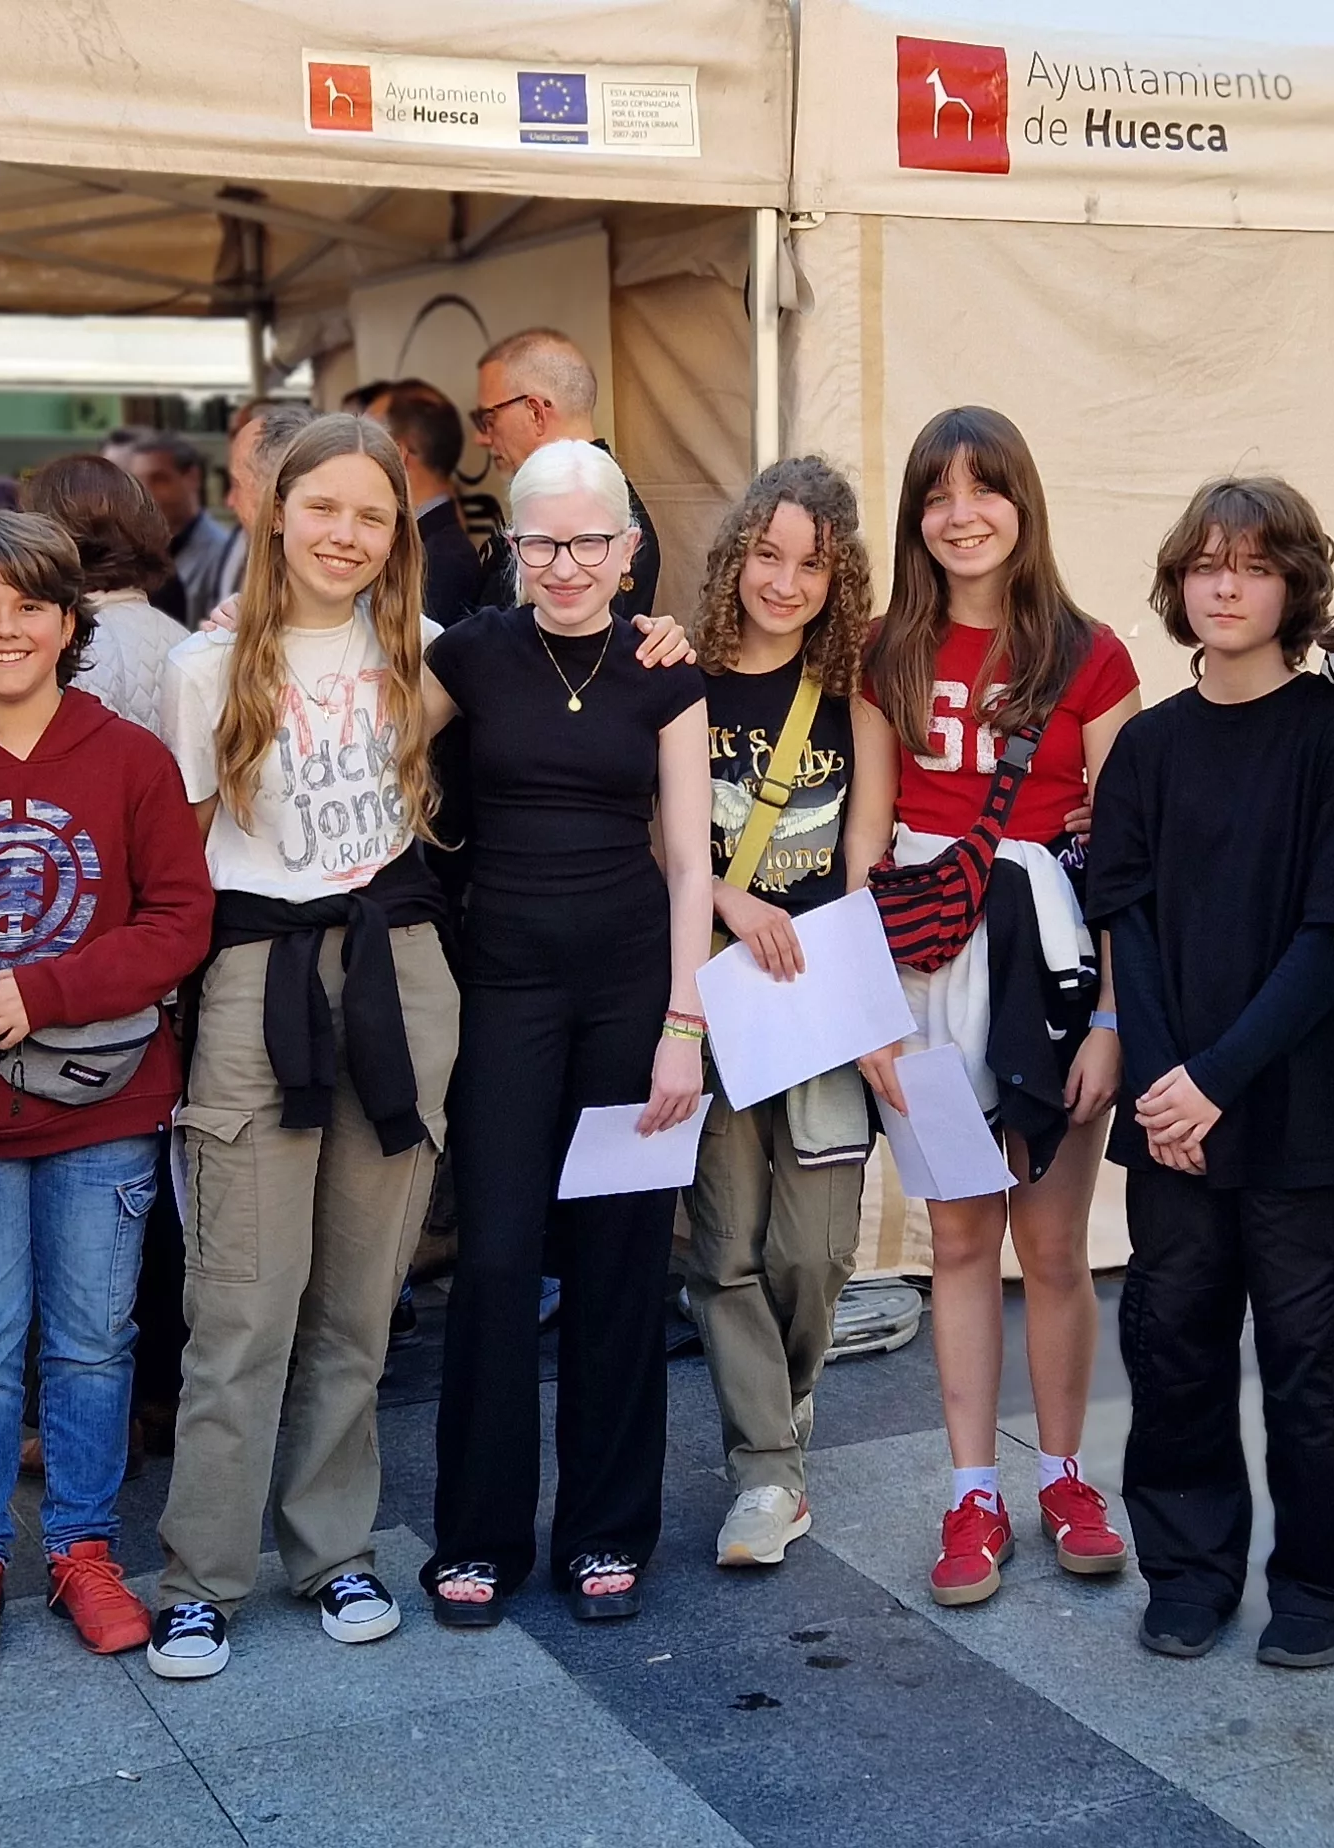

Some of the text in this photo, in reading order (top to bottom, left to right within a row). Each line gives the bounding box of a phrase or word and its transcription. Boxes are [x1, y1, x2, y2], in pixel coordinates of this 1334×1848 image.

[1026, 50, 1294, 102] Ayuntamiento
[385, 81, 507, 106] Ayuntamiento
[610, 89, 627, 97] ESTA
[610, 99, 681, 108] SIDO COFINANCIADA
[385, 105, 479, 125] de Huesca
[612, 120, 649, 128] INICIATIVA
[1023, 105, 1228, 152] de Huesca
[612, 130, 648, 138] 2007-2013
[708, 724, 767, 759] It's
[752, 738, 845, 788] Oly
[277, 783, 405, 873] Jone
[765, 840, 835, 876] long
